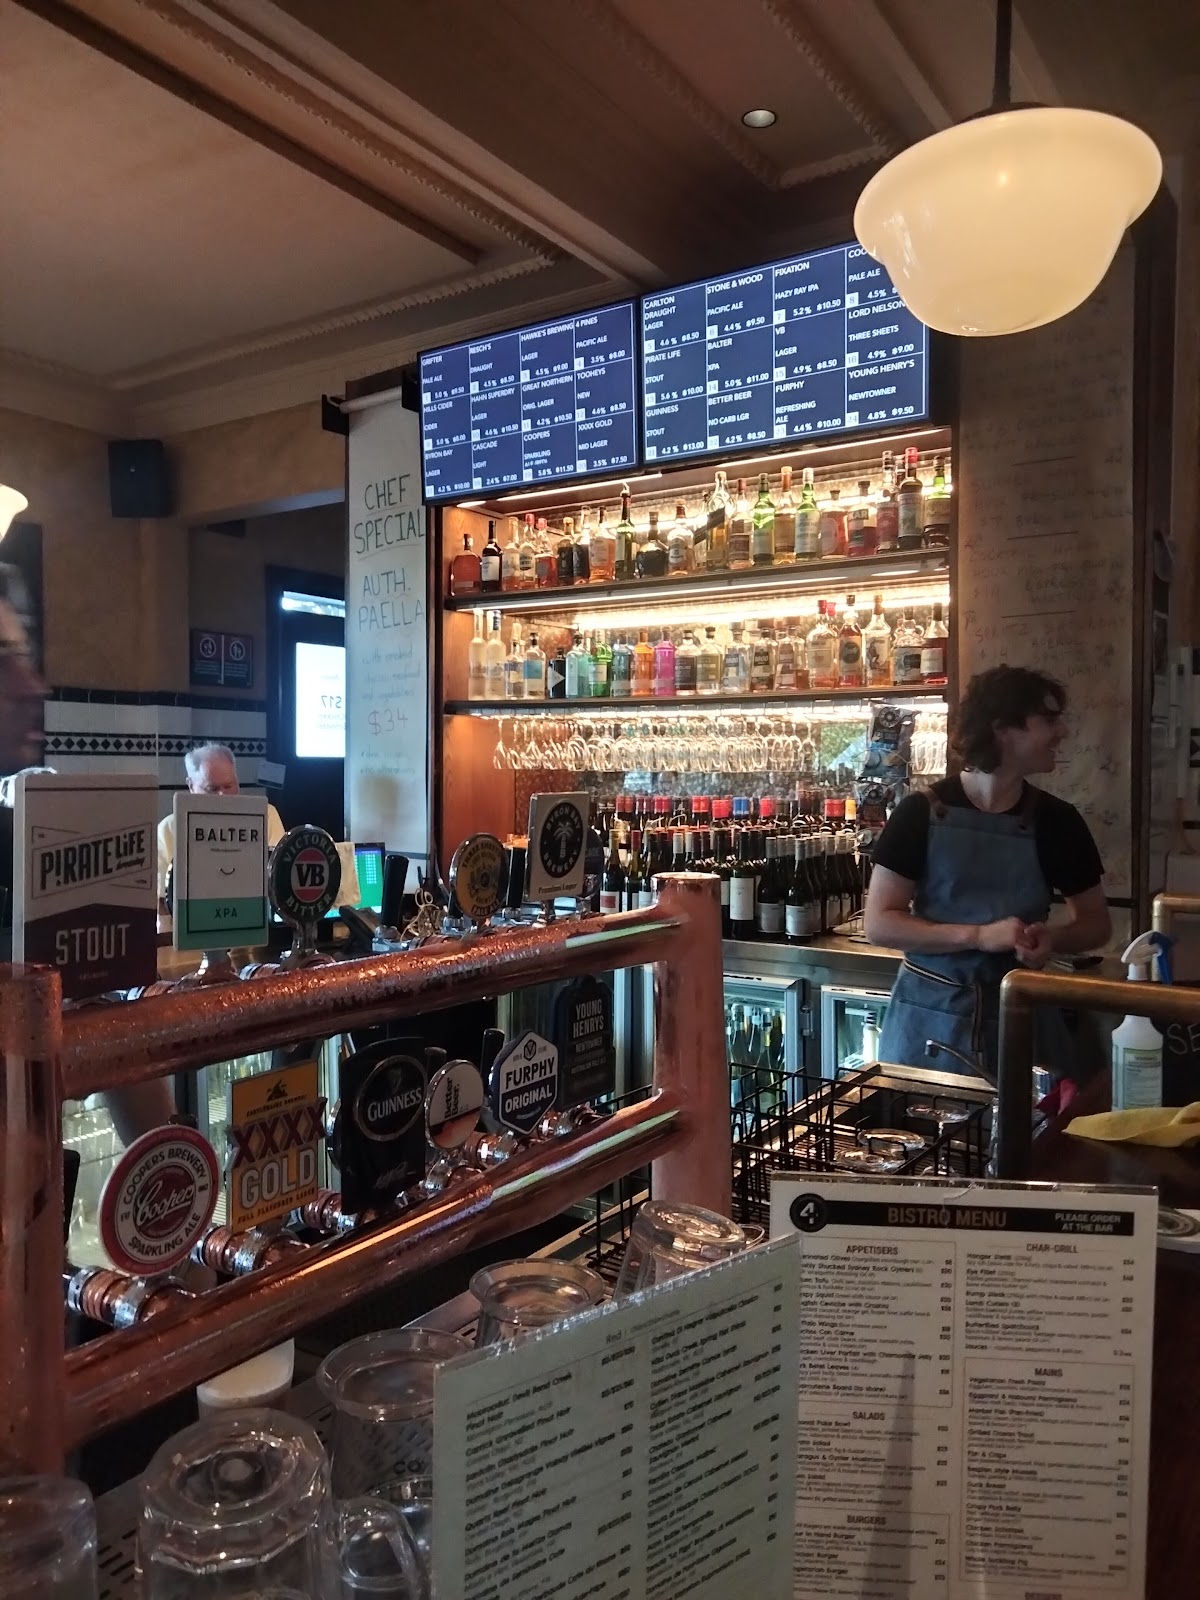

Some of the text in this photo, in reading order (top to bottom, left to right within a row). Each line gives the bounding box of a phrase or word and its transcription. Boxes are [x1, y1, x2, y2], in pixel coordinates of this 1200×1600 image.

[775, 262, 809, 277] FIXATION
[849, 268, 880, 282] PALE ALE
[707, 274, 763, 294] STONE & WOOD
[775, 289, 793, 300] HAZY
[808, 283, 819, 292] IPA
[644, 296, 675, 310] CARLTON
[707, 301, 743, 316] PACIFIC ALE
[817, 299, 841, 311] $10.50
[645, 306, 676, 320] DRAUGHT
[849, 301, 906, 319] LORD NELSON
[581, 316, 598, 327] PINES
[645, 321, 664, 331] LAGER
[746, 317, 765, 327] $9.50
[521, 323, 573, 341] HAWKE'S BREWING
[775, 327, 785, 335] VB
[849, 325, 899, 342] THREE SHEETS
[576, 335, 607, 348] PACIFIC ALE
[708, 338, 732, 350] BALTER
[470, 343, 491, 354] RESCH'S
[775, 347, 797, 357] LAGER
[892, 344, 914, 355] $9.00
[422, 356, 442, 366] GRIFTER
[522, 352, 538, 361] LAGER
[645, 350, 681, 363] PIRATE LIFE
[470, 363, 493, 373] DRAUGHT
[708, 363, 720, 371] XPA
[817, 359, 838, 370] $8.50
[849, 359, 915, 379] YOUNG HENRY'S
[577, 368, 605, 380] TOOHEYS
[645, 374, 664, 384] STOUT
[522, 375, 573, 391] GREAT NORTHERN
[776, 380, 804, 393] FURPHY
[488, 388, 515, 399] SUPERDRY
[577, 391, 590, 399] NEW
[708, 391, 752, 405] BETTER BEER
[849, 386, 896, 401] NEWTOWNER
[424, 401, 453, 413] HILLS CIDER
[538, 399, 554, 407] LAGER
[776, 400, 816, 414] REFRESHING
[472, 413, 487, 421] LAGER
[646, 405, 679, 417] GUINNESS
[578, 419, 612, 431] XXXX GOLD
[708, 413, 749, 426] NO CARB LGR
[776, 415, 788, 423] ALE
[524, 431, 550, 441] COOPERS
[646, 428, 665, 437] STOUT
[472, 441, 497, 450] CASCADE
[590, 440, 608, 449] LAGER
[425, 451, 442, 460] BYRON
[524, 450, 551, 460] SPARKLING
[473, 461, 486, 469] LIGHT
[426, 469, 440, 477] LAGER
[365, 474, 410, 510] CHEF
[354, 508, 425, 554] SPECIAL
[363, 568, 411, 597] AUTH.
[358, 599, 425, 632] PAELLA
[368, 707, 408, 736] $34
[546, 805, 569, 830] BYRON
[195, 828, 258, 842] BALTER
[283, 833, 336, 863] VICTORIA
[543, 849, 578, 873] BREWERY
[295, 863, 324, 887] VB
[538, 883, 577, 894] Premium Lager
[285, 893, 332, 917] BITTER
[215, 907, 237, 919] XPA
[55, 923, 130, 965] STOUT
[576, 999, 602, 1020] YOUNG
[573, 1015, 604, 1038] HENRYS
[506, 1057, 554, 1089] FURPHY
[368, 1088, 422, 1121] GUINNESS
[445, 1077, 453, 1119] Better
[505, 1085, 552, 1113] ORIGINAL
[232, 1098, 328, 1168] XXXX
[124, 1148, 207, 1204] COOPERS BREWERY
[241, 1148, 315, 1208] GOLD
[134, 1180, 194, 1227] Coopers
[238, 1214, 254, 1223] FULL
[296, 1188, 315, 1201] LAGER
[888, 1207, 950, 1225] BISTRO
[956, 1209, 1007, 1228] MENU
[1055, 1213, 1121, 1223] PLEASE ORDER
[128, 1212, 201, 1256] SPARKLING ALE
[1062, 1223, 1114, 1232] AT THE BAR
[846, 1245, 899, 1255] APPETISERS
[1026, 1243, 1079, 1253] CHAR-GRILL
[1034, 1368, 1063, 1377] MAINS
[852, 1411, 885, 1420] SALADS
[847, 1515, 887, 1525] BURGERS
